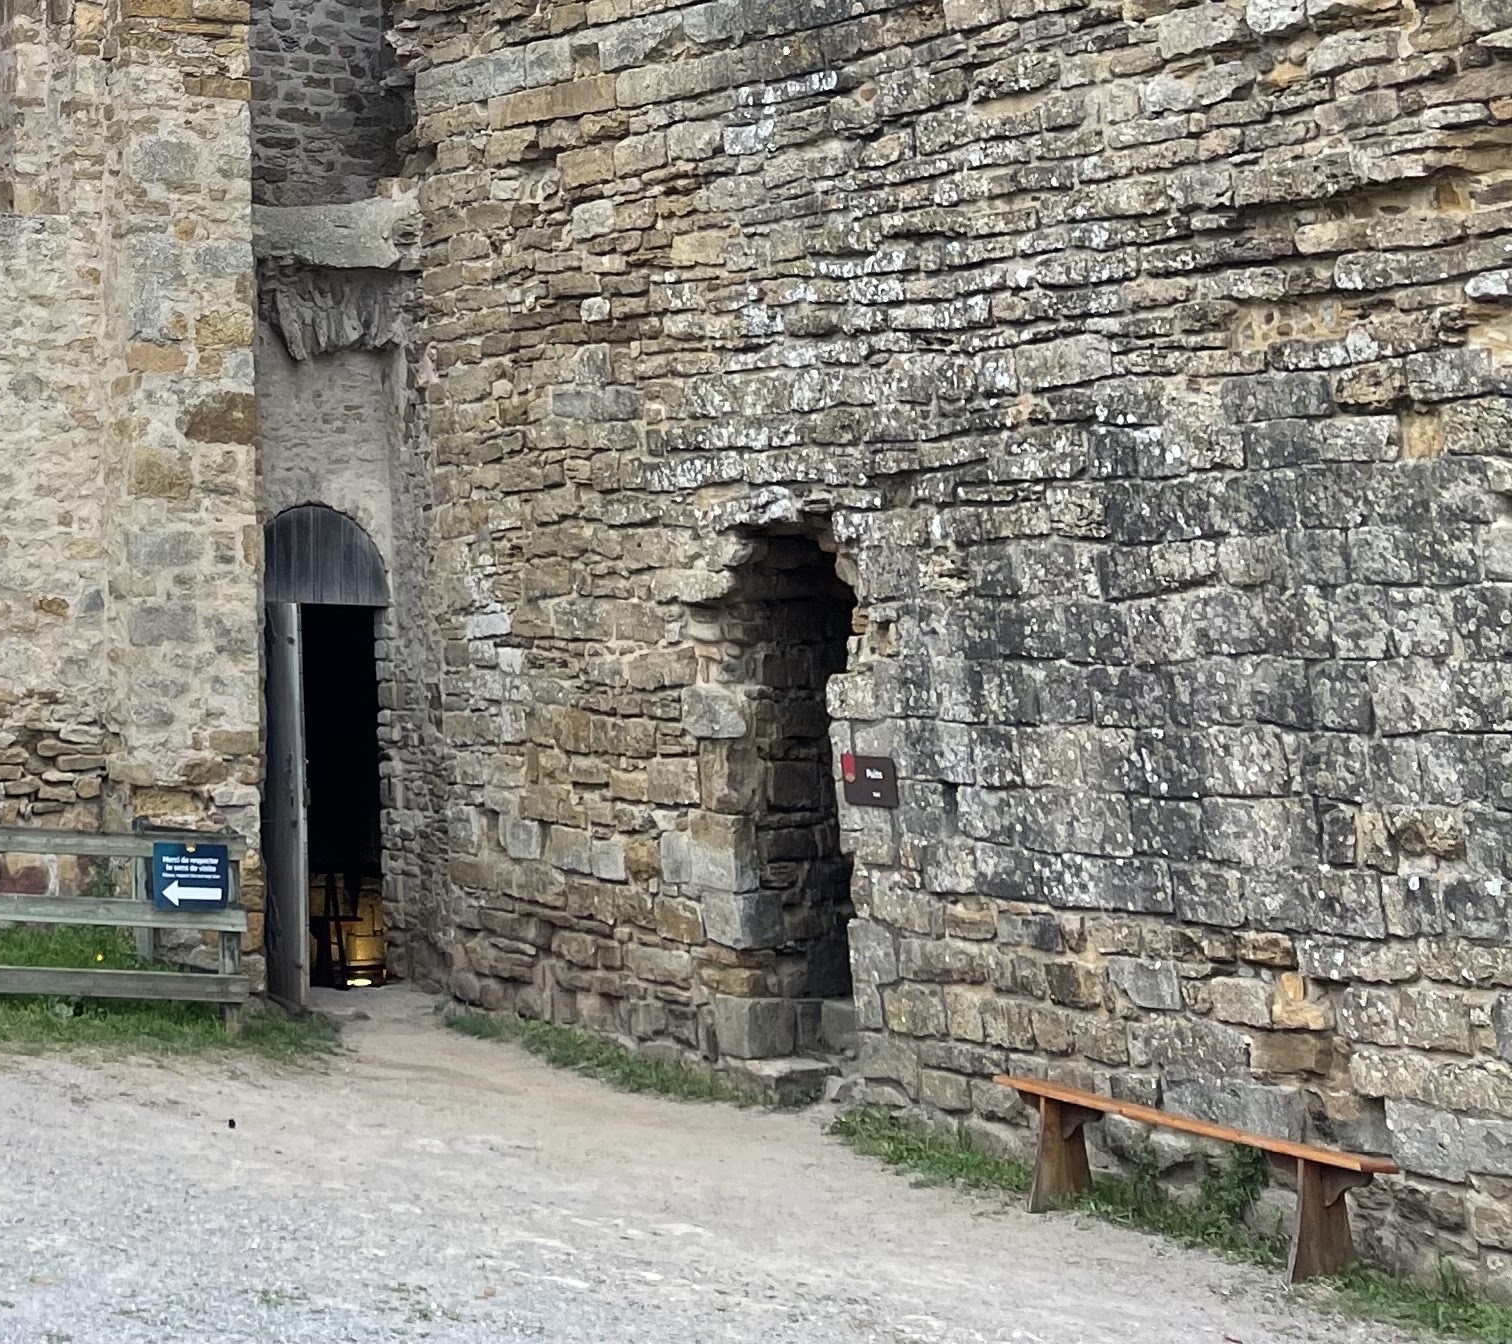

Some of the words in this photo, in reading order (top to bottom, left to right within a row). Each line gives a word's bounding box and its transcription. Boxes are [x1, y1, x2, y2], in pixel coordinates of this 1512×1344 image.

[162, 855, 180, 863] Merci
[181, 856, 189, 864] de
[190, 857, 219, 865] respecter
[198, 865, 217, 873] visite
